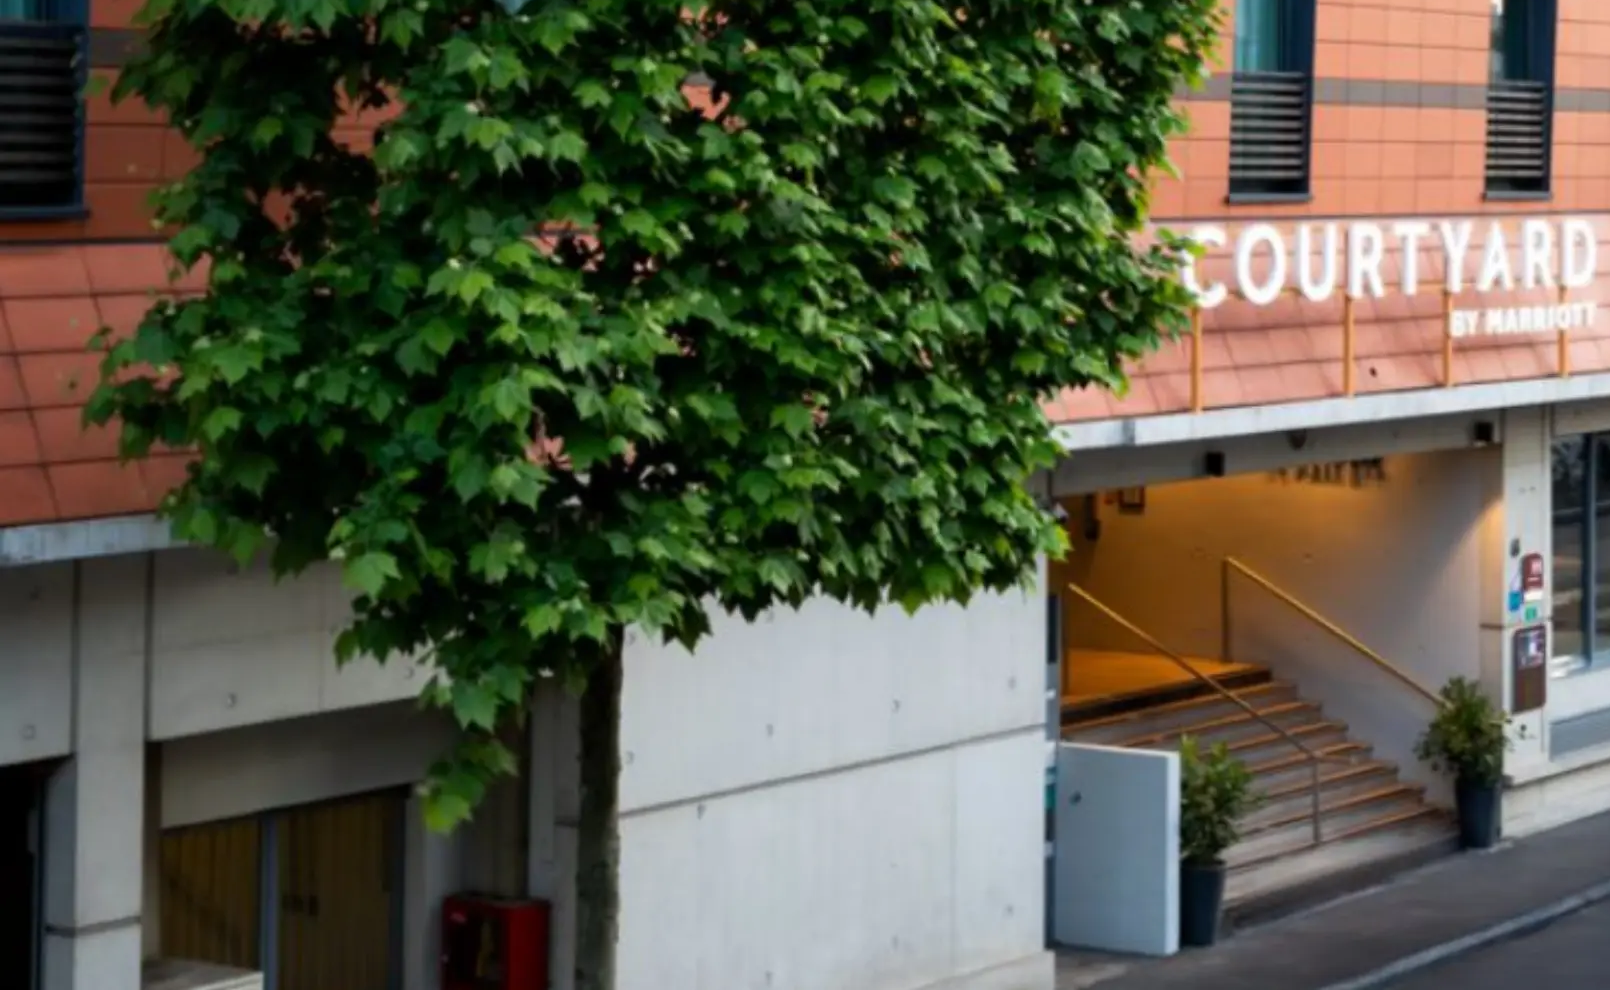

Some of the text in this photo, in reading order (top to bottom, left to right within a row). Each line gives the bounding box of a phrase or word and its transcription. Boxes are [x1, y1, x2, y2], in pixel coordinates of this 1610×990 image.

[1180, 217, 1597, 308] COURTYARD
[1451, 301, 1597, 337] BY MARRIOTT
